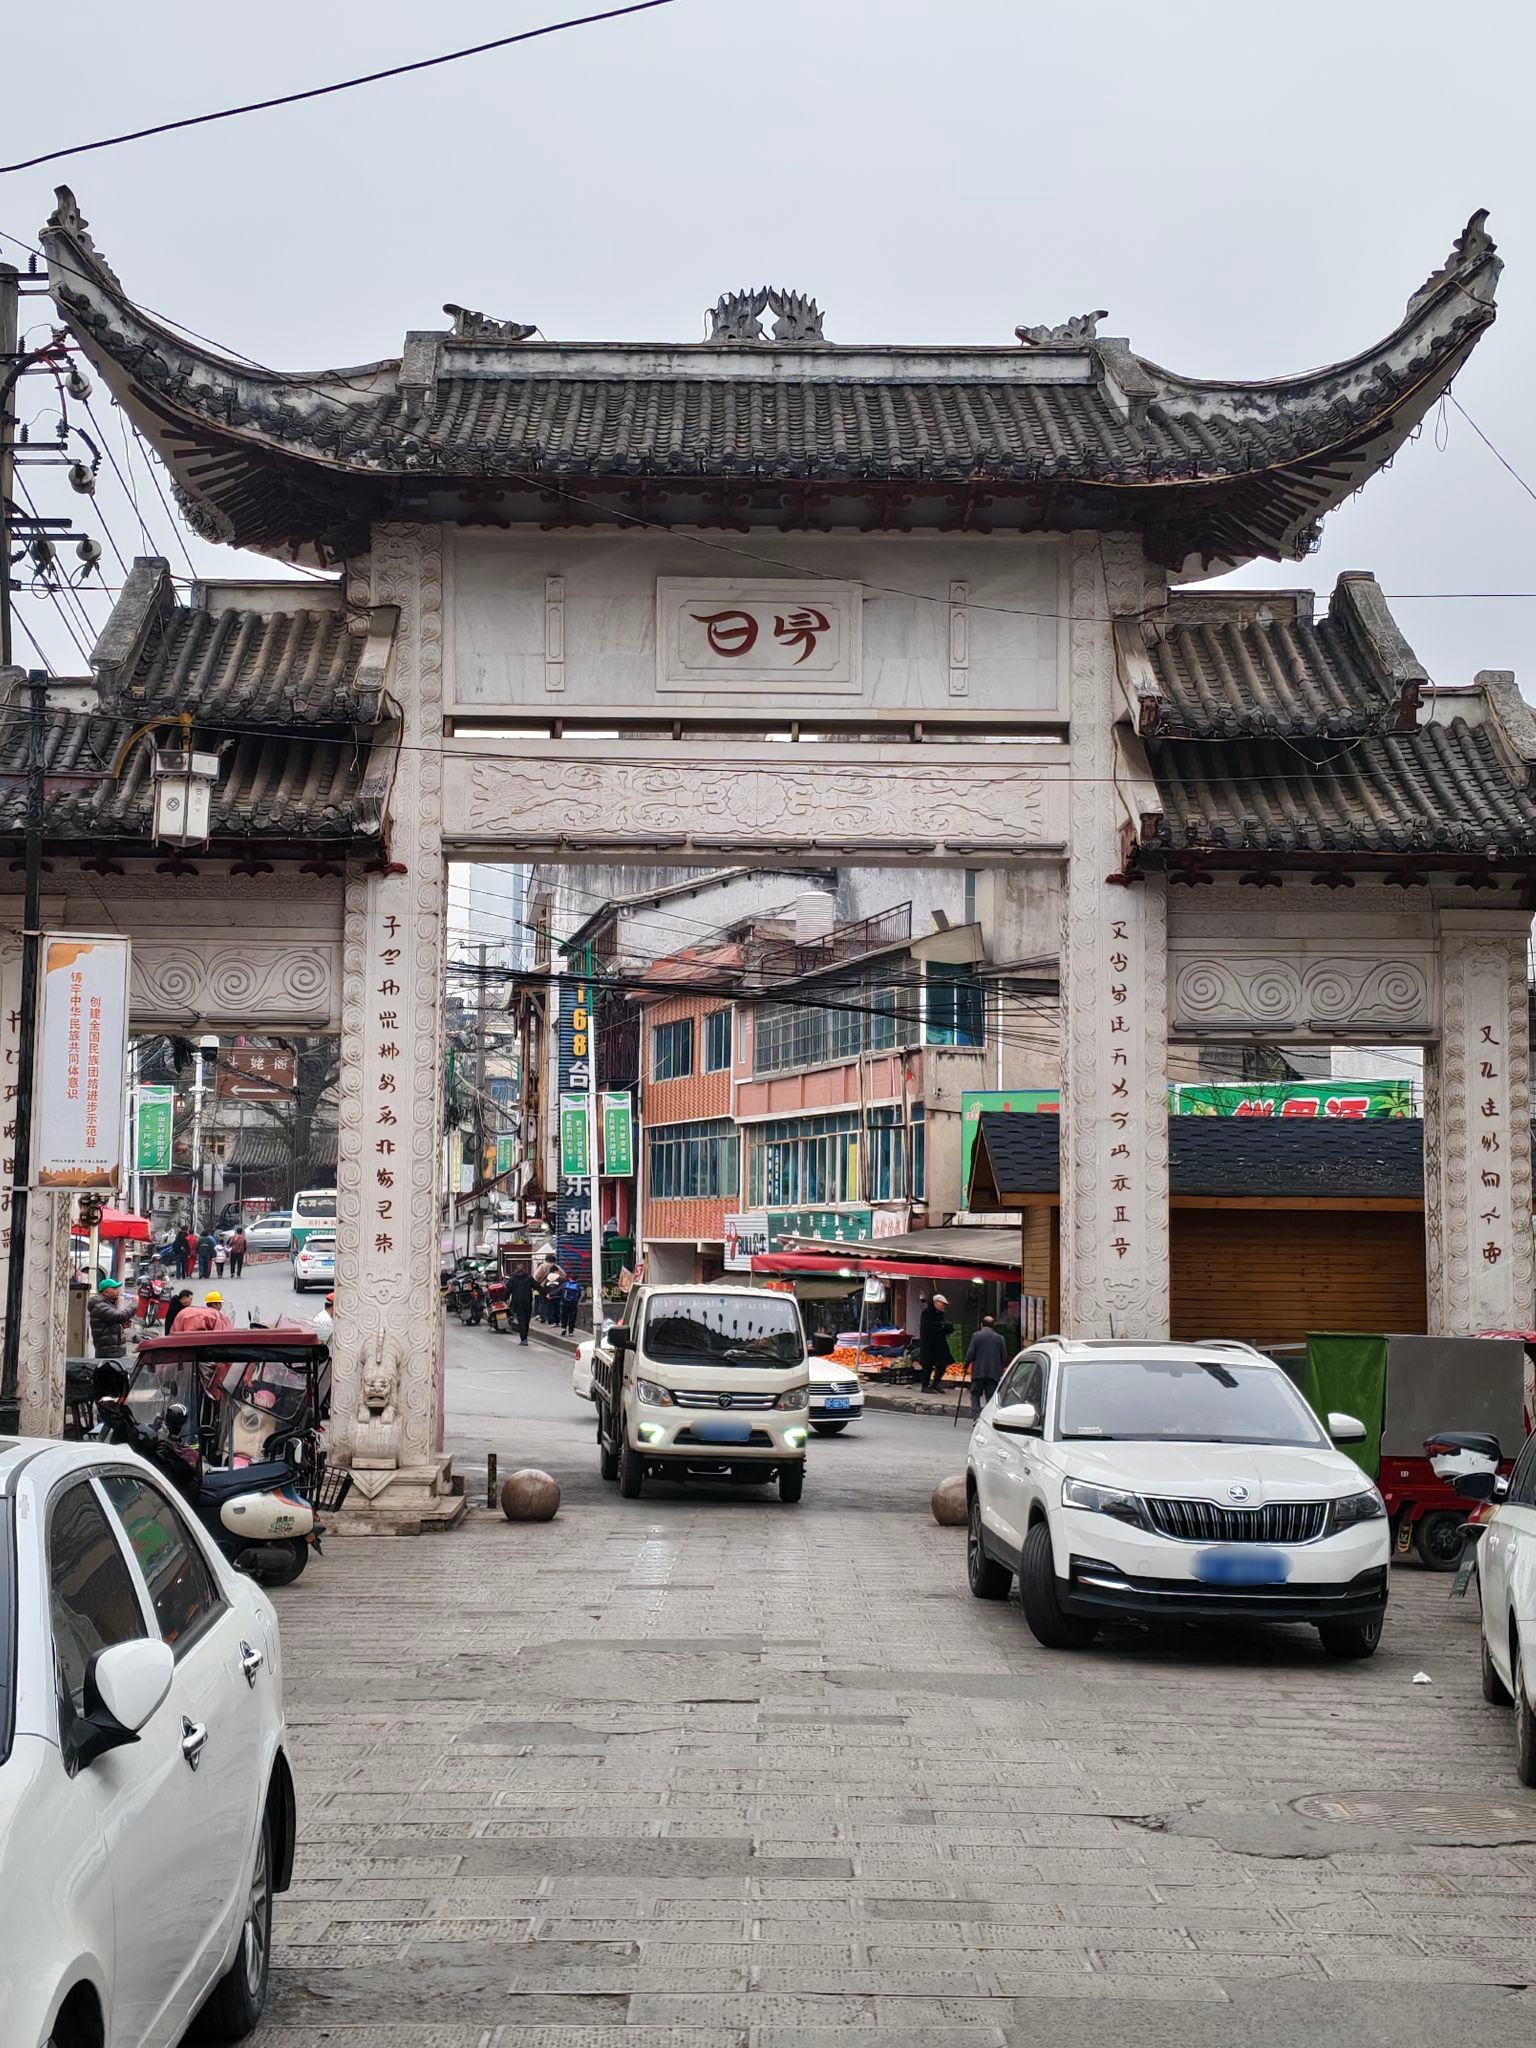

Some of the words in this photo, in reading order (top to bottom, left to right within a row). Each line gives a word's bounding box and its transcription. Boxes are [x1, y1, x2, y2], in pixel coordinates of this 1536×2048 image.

[85, 996, 101, 1148] 创建全国民族团结进步示范县
